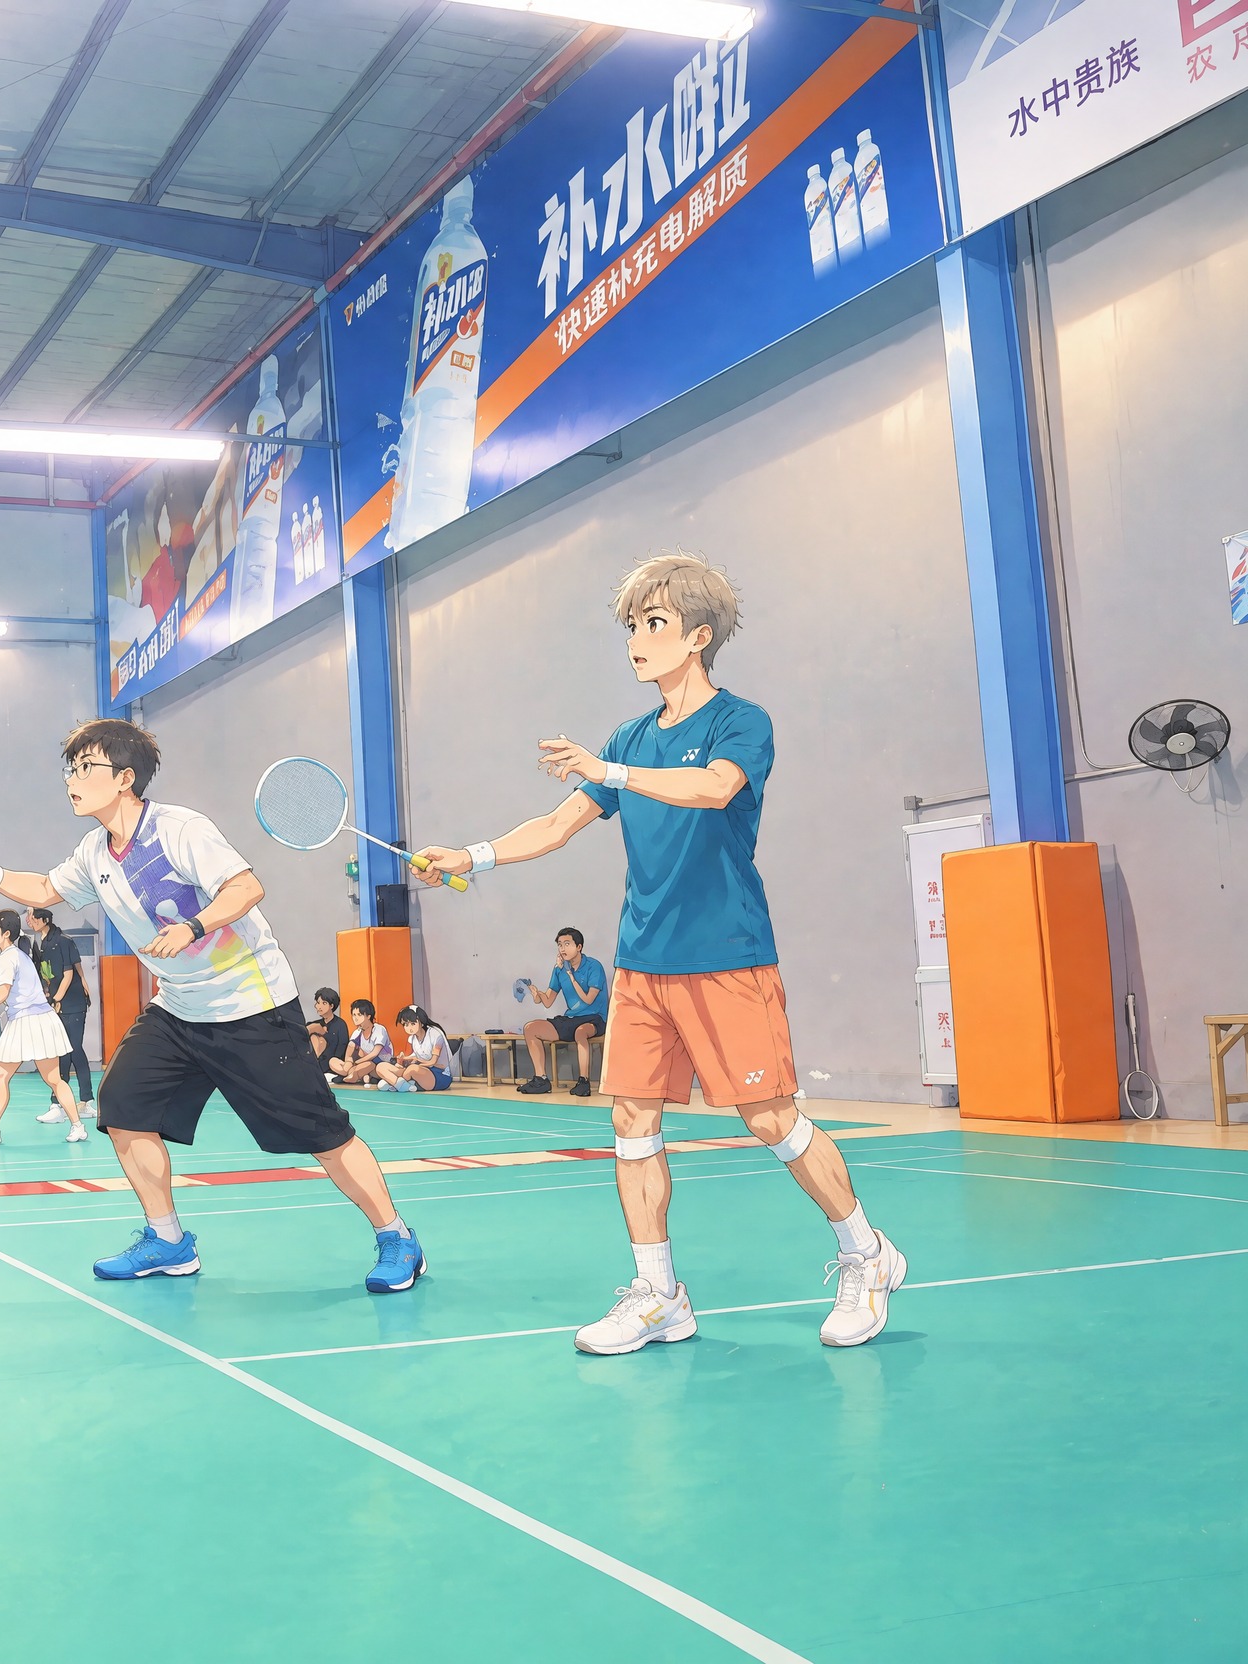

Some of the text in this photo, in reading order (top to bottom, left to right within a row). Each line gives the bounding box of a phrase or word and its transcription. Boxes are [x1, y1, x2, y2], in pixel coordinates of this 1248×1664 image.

[537, 34, 751, 319] 补水啦
[1008, 38, 1141, 138] 水中贵族
[554, 144, 748, 356] 快速补充电解质
